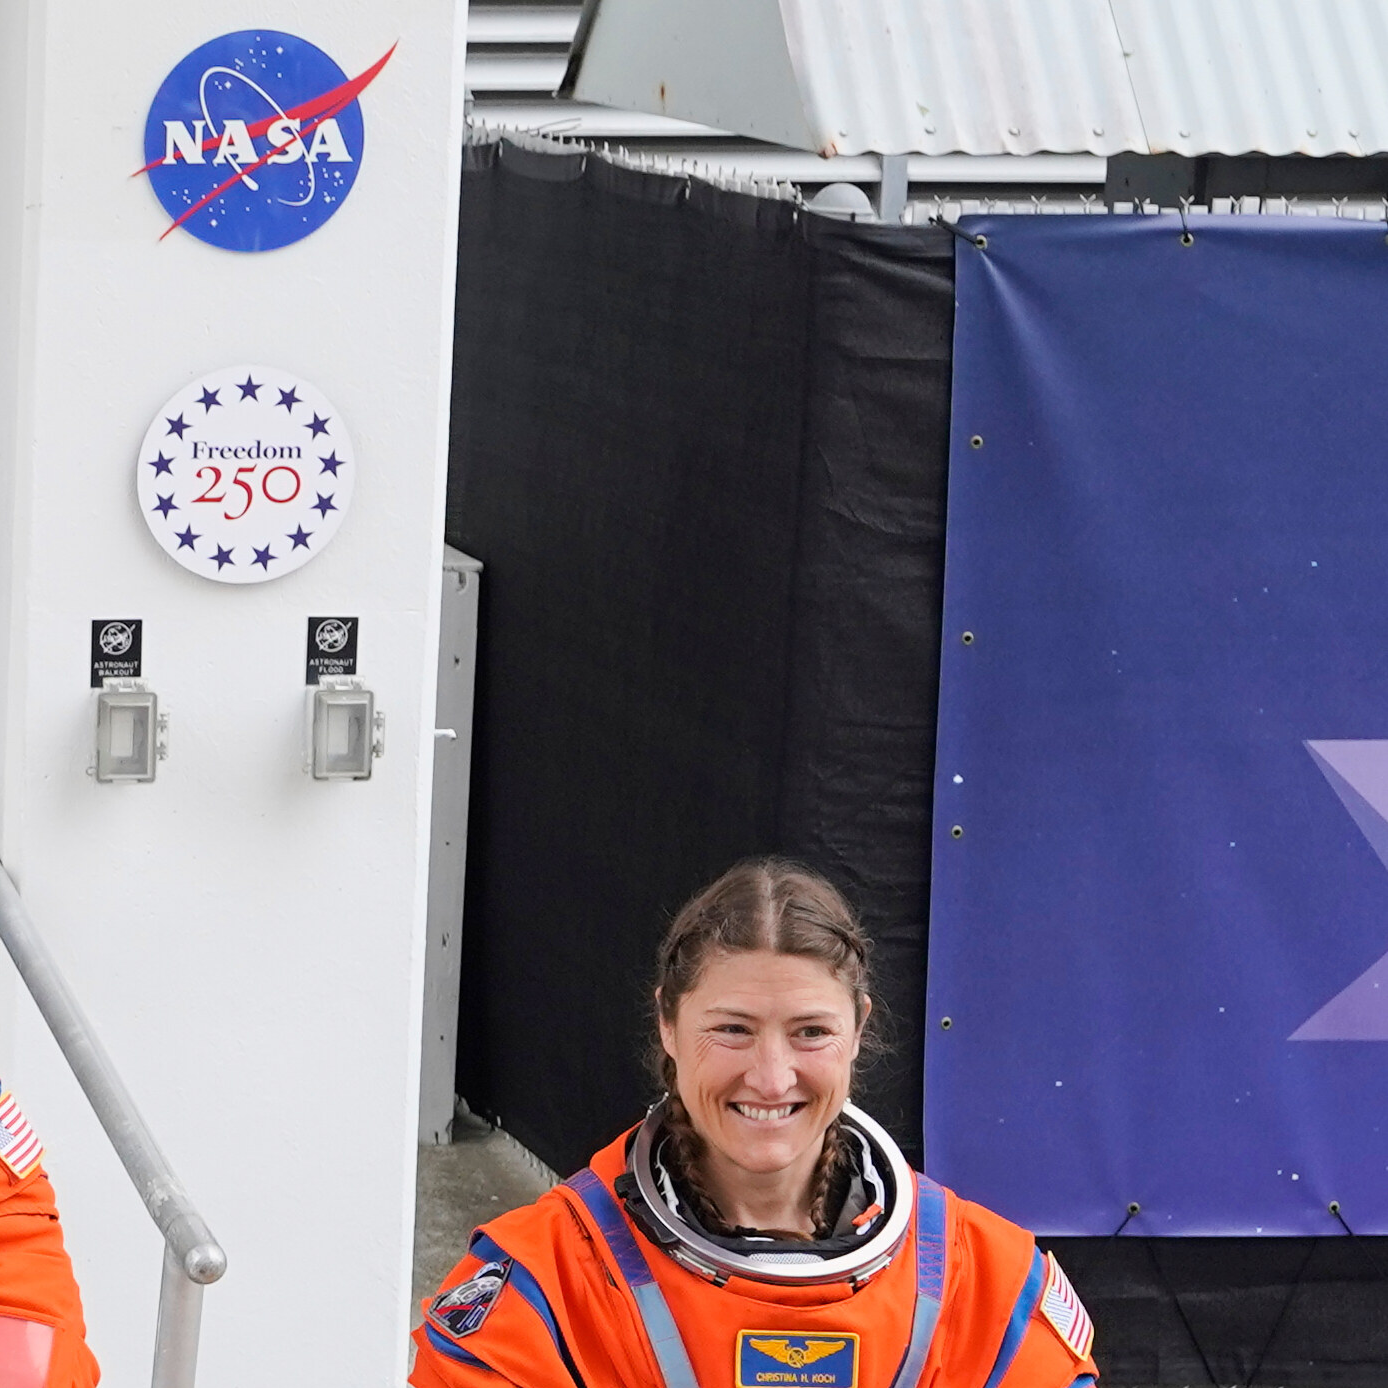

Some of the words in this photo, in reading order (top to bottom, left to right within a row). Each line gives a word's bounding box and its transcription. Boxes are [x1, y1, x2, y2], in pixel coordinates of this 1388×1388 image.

[162, 118, 354, 165] NASA
[191, 440, 302, 460] Freedom
[191, 463, 301, 520] 250
[93, 661, 138, 669] ASTRONAUT
[309, 658, 353, 666] ASTRONAUT
[756, 1372, 797, 1383] CHRISTINA
[812, 1374, 835, 1383] KOCH
